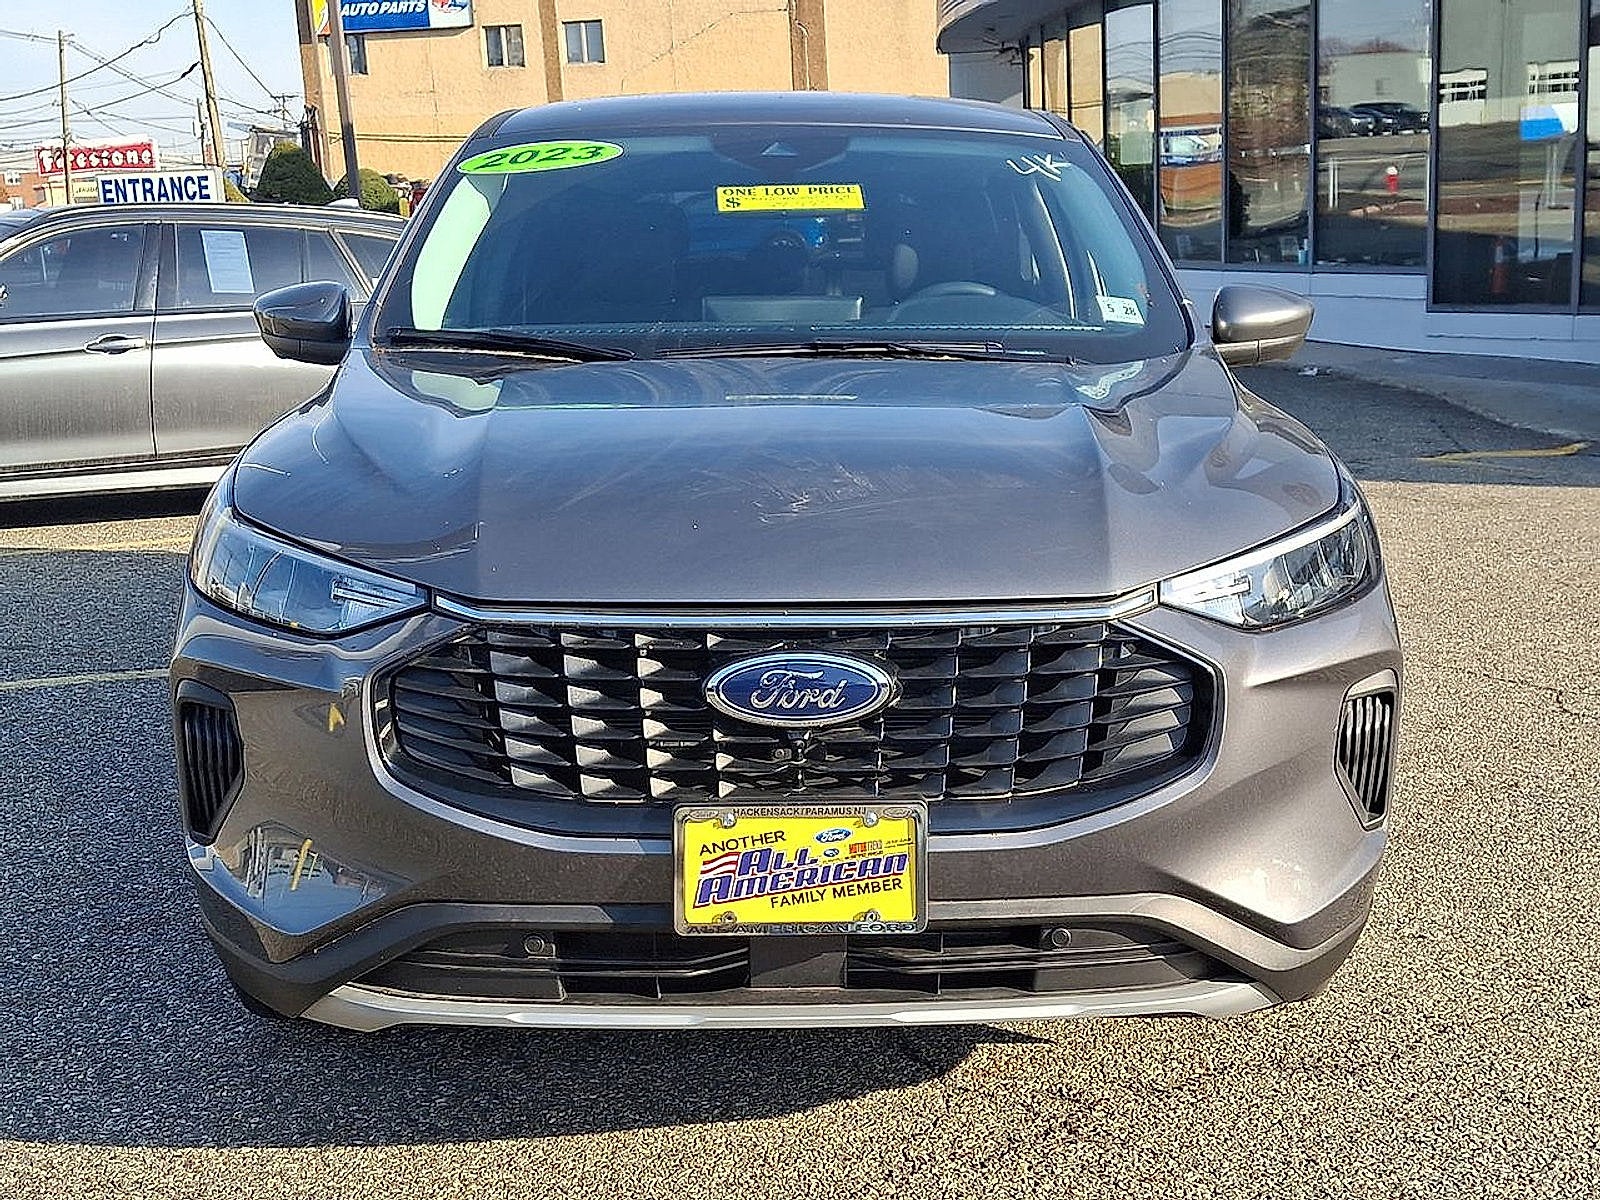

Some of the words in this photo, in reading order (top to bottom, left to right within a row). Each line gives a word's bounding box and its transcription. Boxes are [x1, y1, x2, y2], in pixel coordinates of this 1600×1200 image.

[341, 2, 378, 16] AUTO
[380, 0, 426, 14] PARTS
[478, 144, 604, 170] 2023
[1006, 154, 1071, 182] 4K
[100, 175, 212, 203] ENTRANCE
[722, 187, 757, 196] ONE
[764, 186, 800, 196] LOW
[808, 185, 857, 195] PRICE
[725, 196, 742, 209] $
[1106, 303, 1115, 313] 5
[750, 669, 849, 709] Ford
[699, 830, 786, 856] ANOTHER
[695, 853, 909, 907] AMERICAN
[770, 889, 828, 909] FAMILY
[831, 877, 903, 899] MEMBER
[735, 923, 850, 934] AMERICAN
[859, 922, 916, 933] FORD
